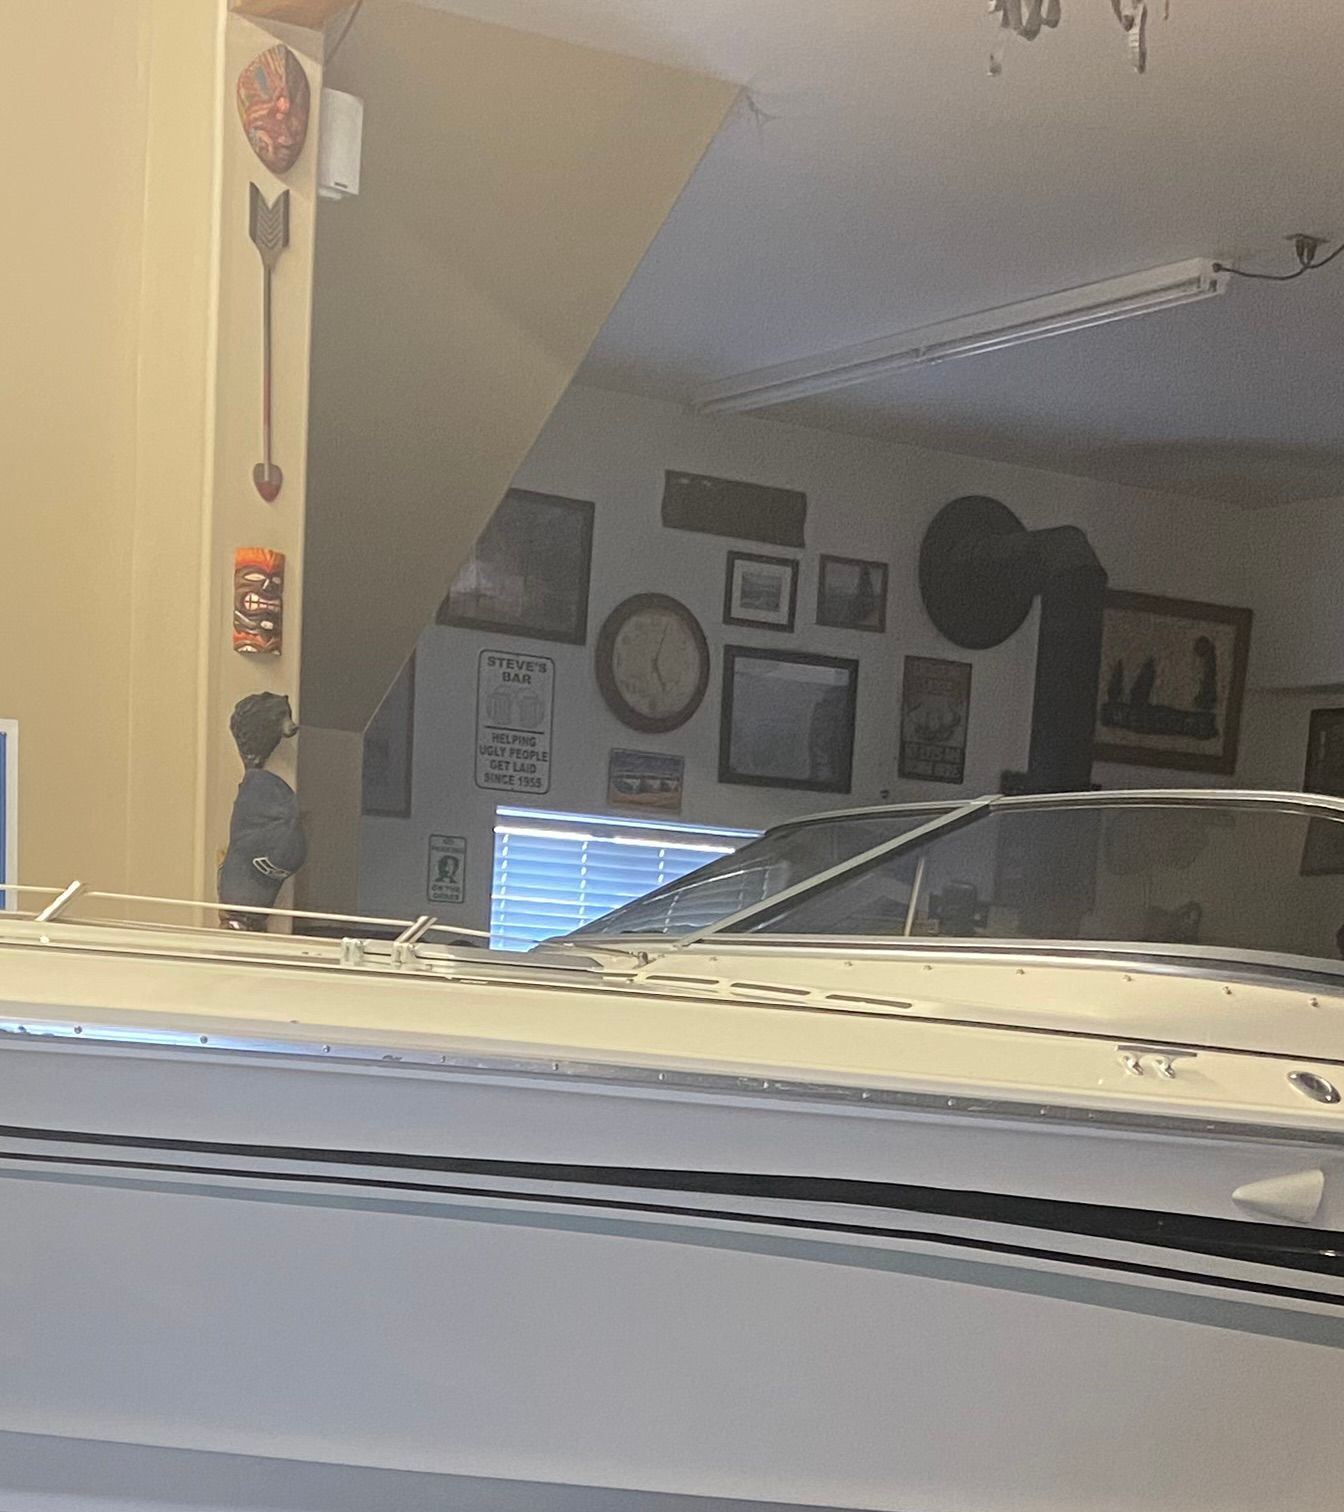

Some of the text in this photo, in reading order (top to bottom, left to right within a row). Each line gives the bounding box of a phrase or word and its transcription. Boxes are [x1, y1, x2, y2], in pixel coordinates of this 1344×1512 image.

[487, 656, 547, 673] STEVE'S
[502, 671, 532, 684] BAR
[492, 732, 536, 747] HELPING
[479, 744, 549, 762] UGLY PEOPLE
[489, 760, 537, 774] GET LAID
[484, 772, 515, 785] SINCE
